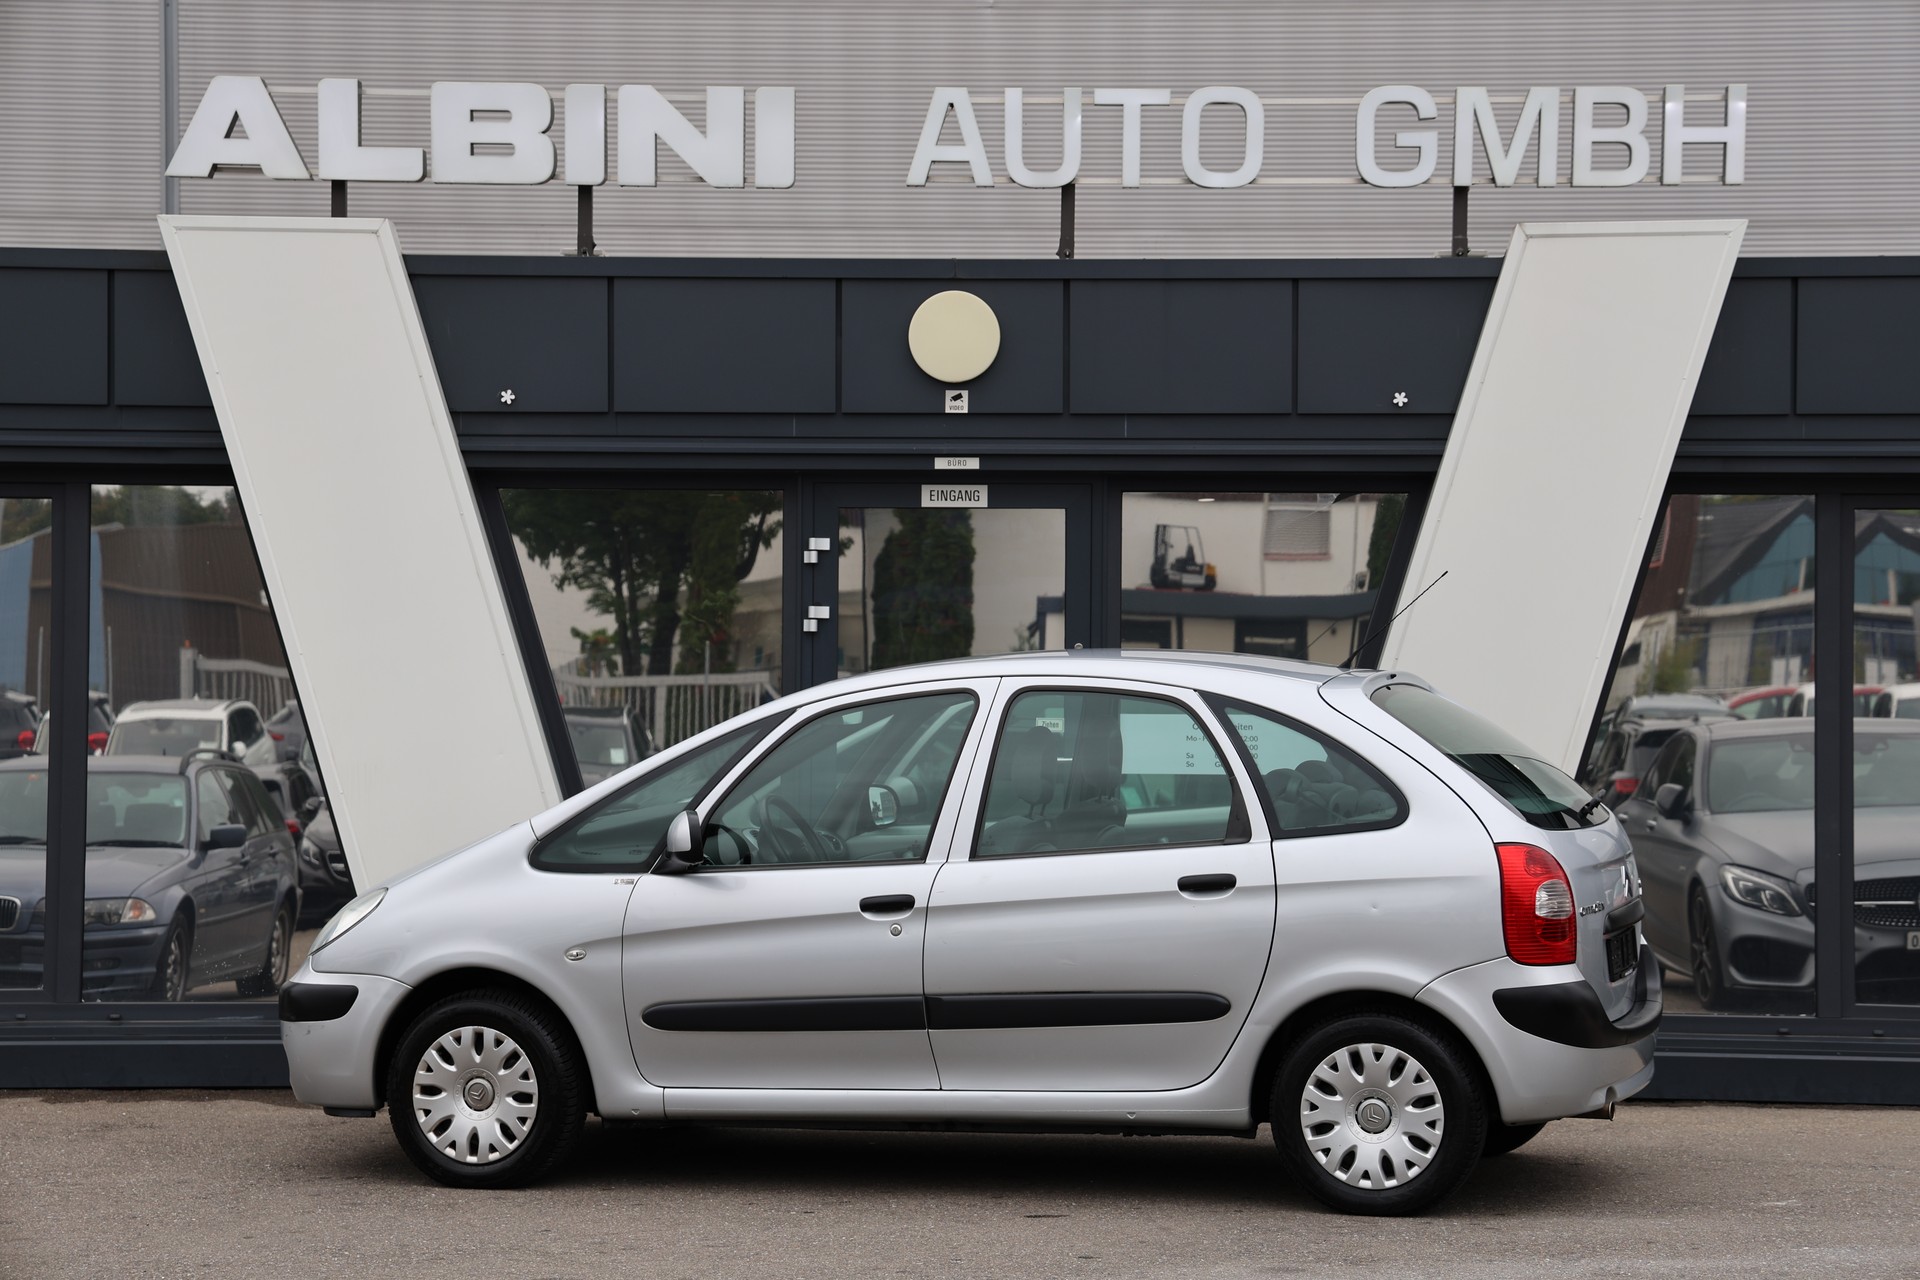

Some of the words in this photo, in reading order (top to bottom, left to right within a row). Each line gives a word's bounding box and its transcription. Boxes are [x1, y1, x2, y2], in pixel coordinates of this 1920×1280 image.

[165, 76, 796, 189] ALBINI
[906, 86, 1265, 188] AUTO
[1355, 84, 1749, 188] GMBH
[947, 458, 967, 467] BÜRO
[929, 489, 980, 502] EINGANG
